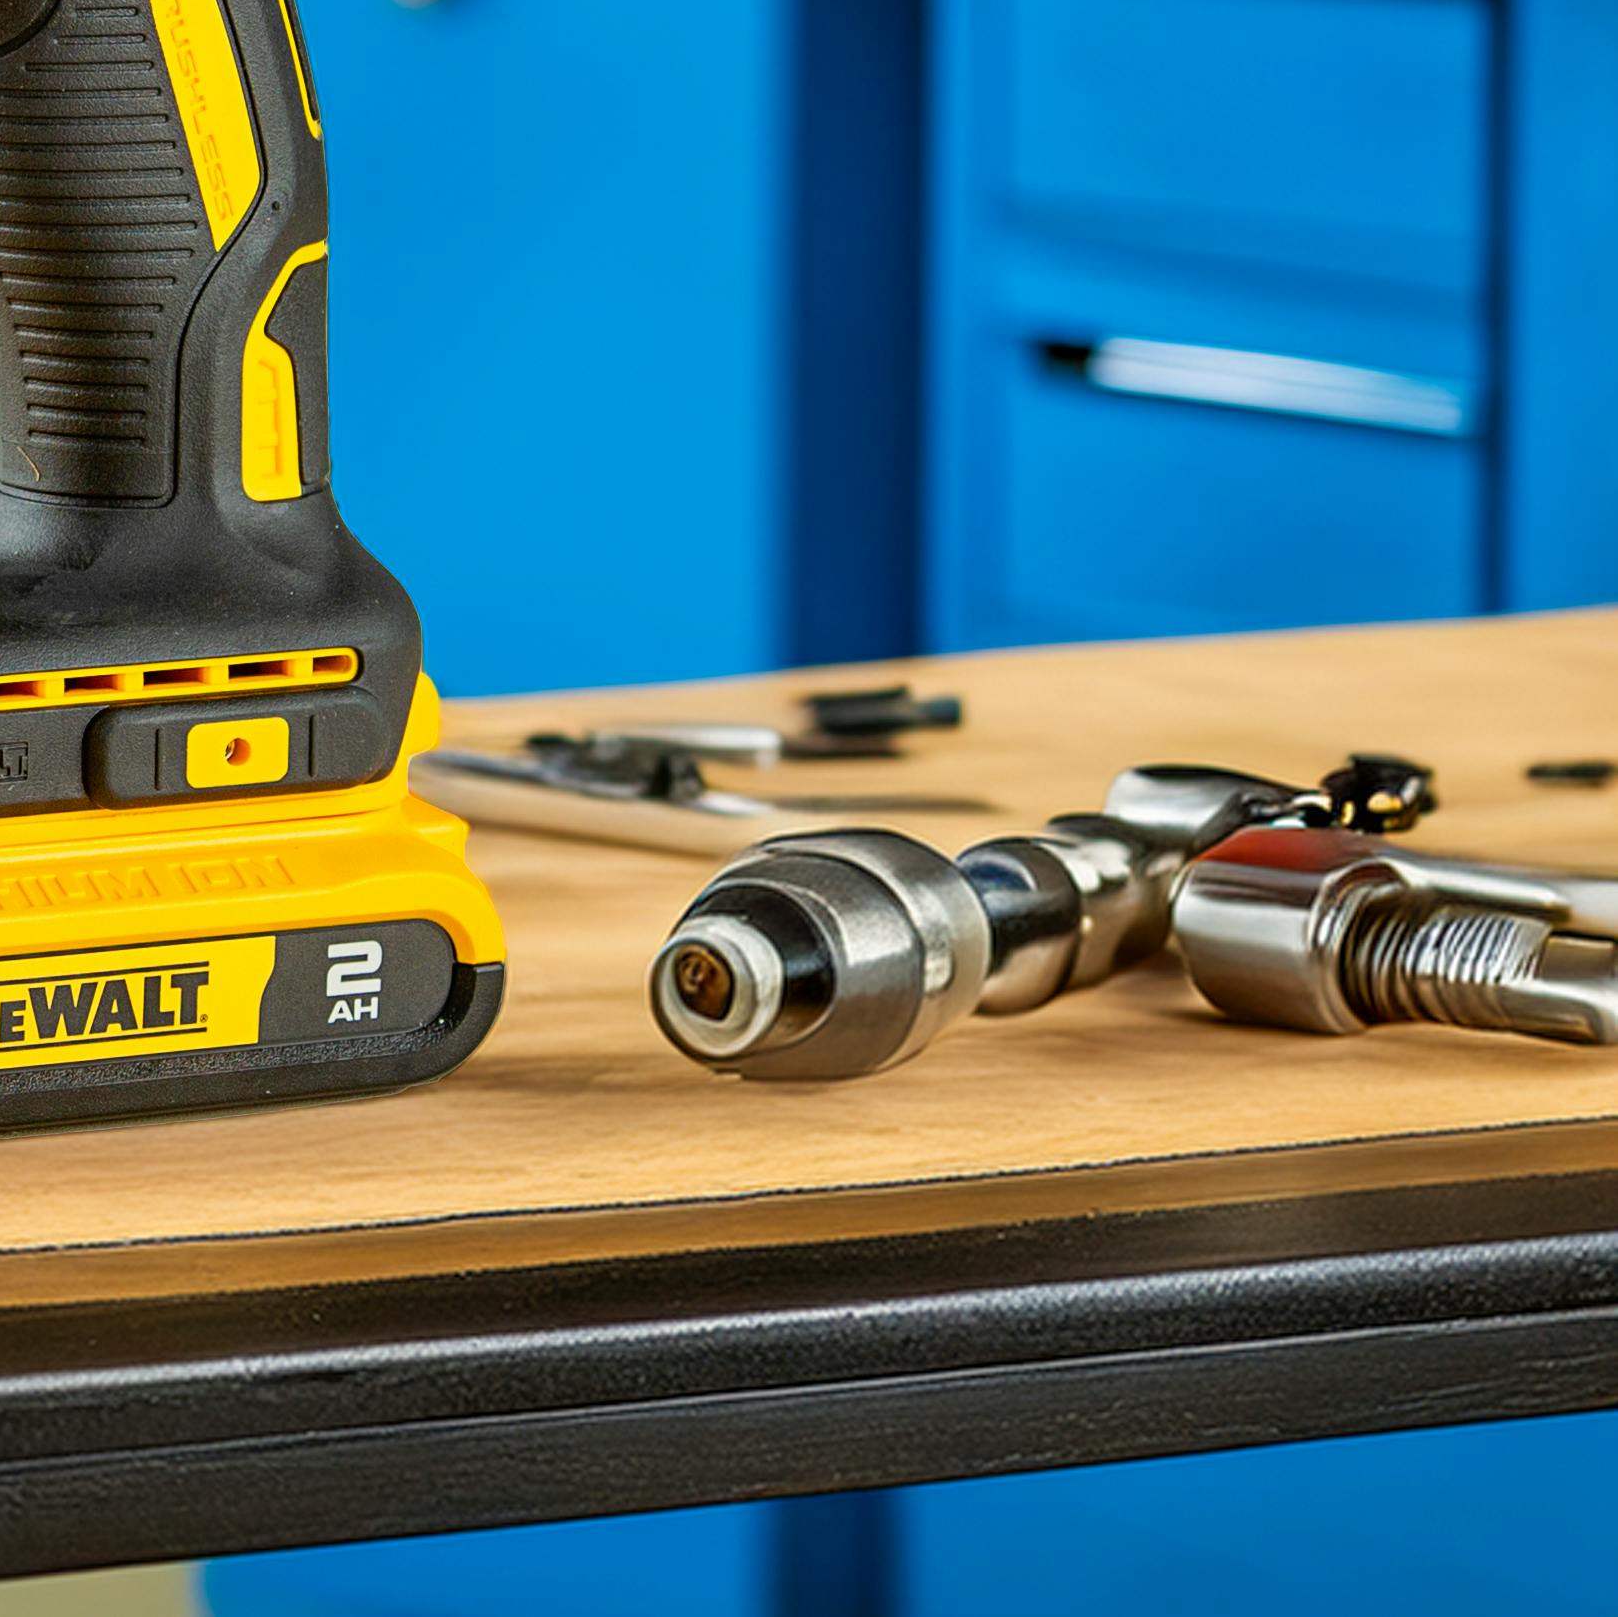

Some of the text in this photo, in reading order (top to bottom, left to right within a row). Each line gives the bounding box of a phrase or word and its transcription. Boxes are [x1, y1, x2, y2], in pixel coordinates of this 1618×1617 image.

[167, 854, 297, 895] ION
[326, 940, 383, 997] 2
[327, 996, 379, 1024] AH
